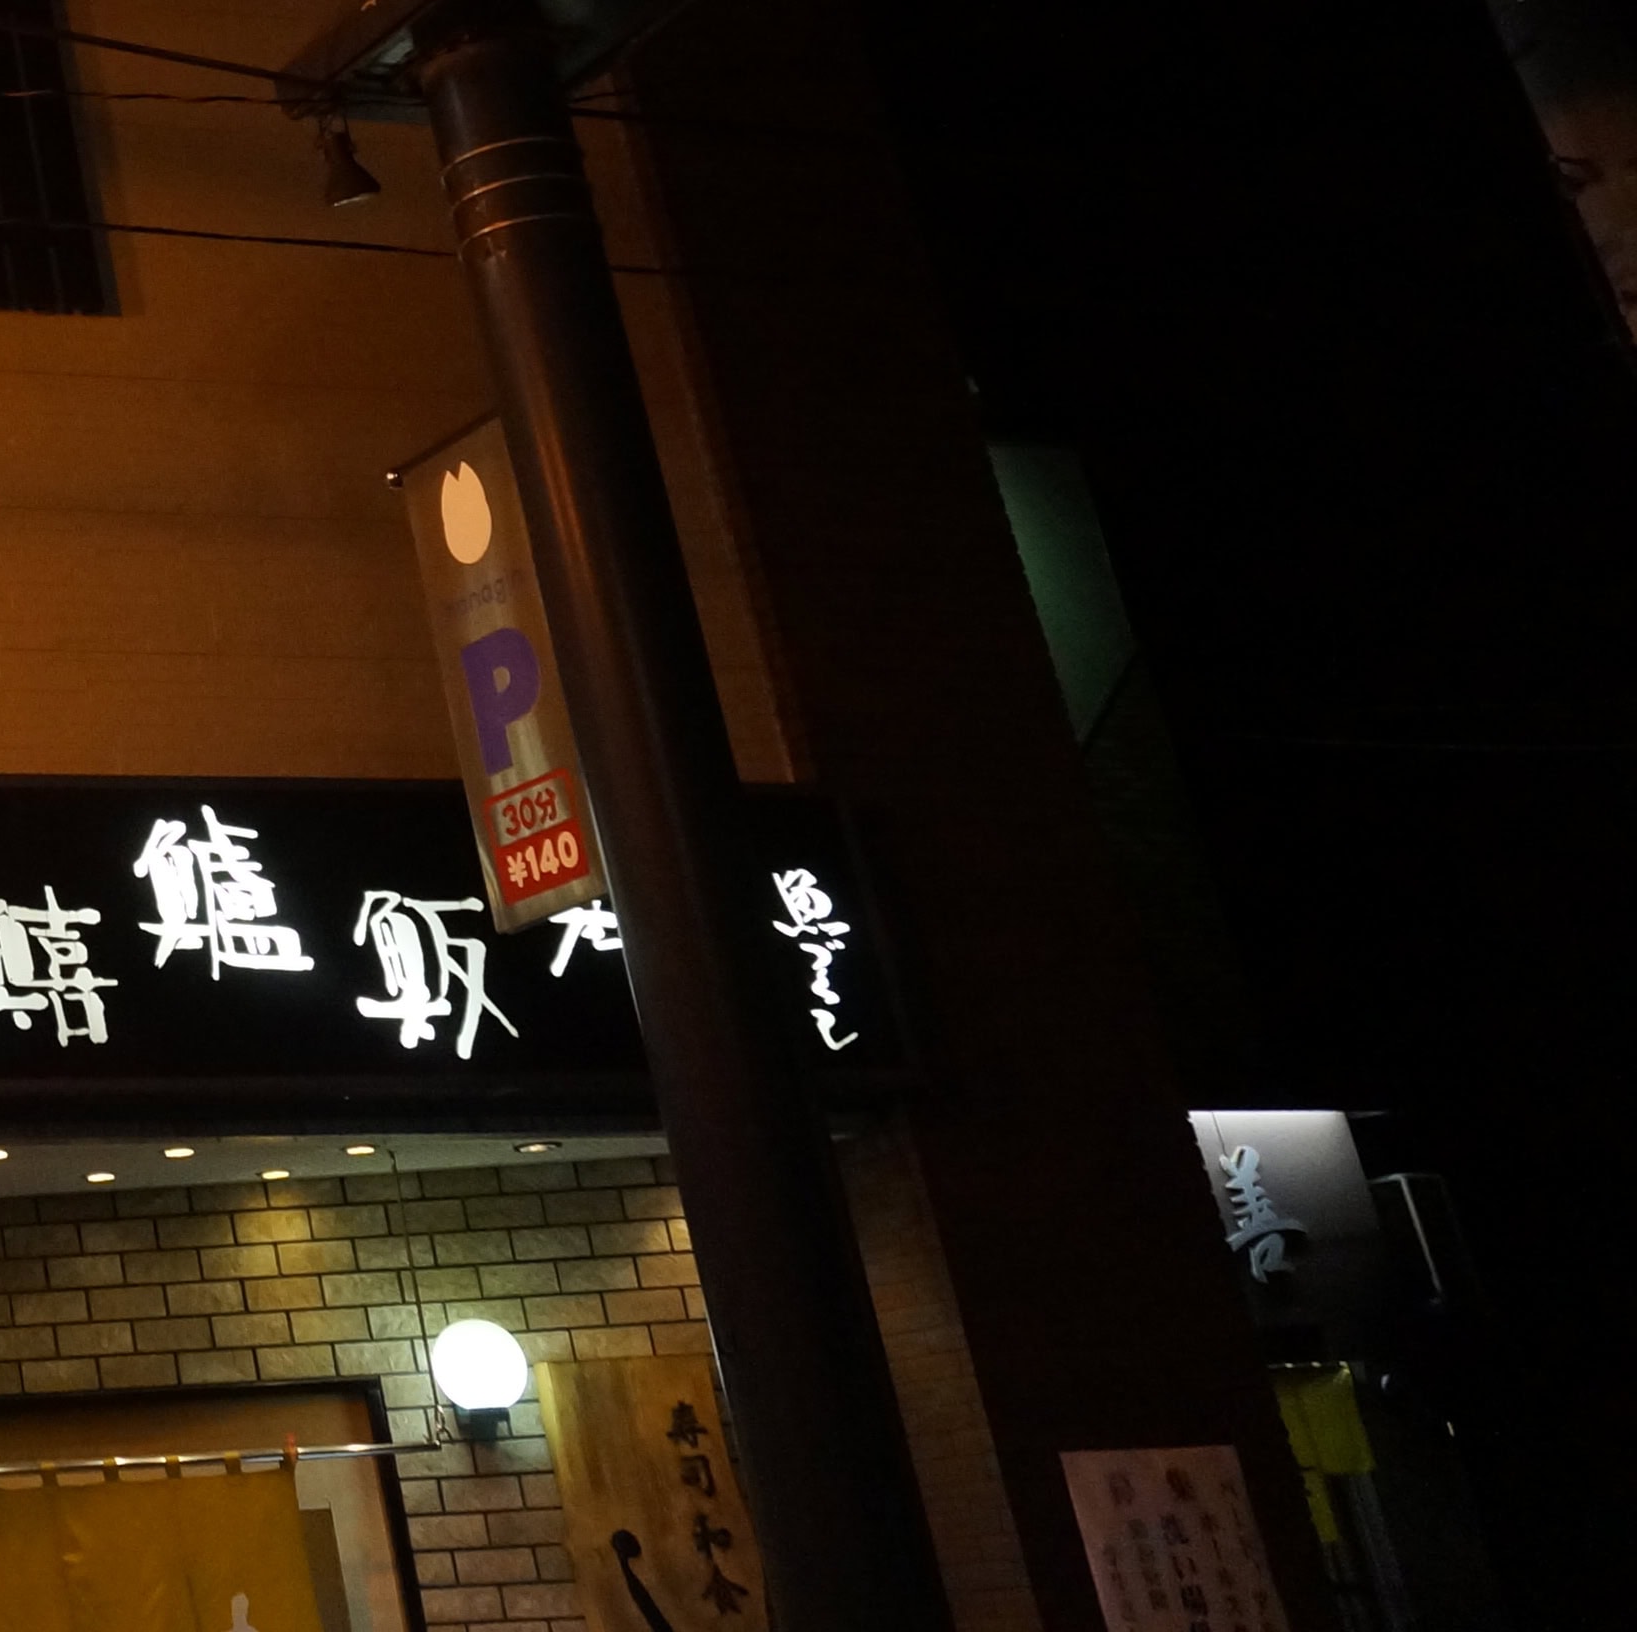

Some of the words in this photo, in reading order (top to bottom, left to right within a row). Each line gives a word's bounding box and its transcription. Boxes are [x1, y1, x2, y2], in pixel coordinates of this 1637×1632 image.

[461, 627, 541, 777] P
[502, 787, 558, 837] 30分
[507, 830, 579, 888] ¥140
